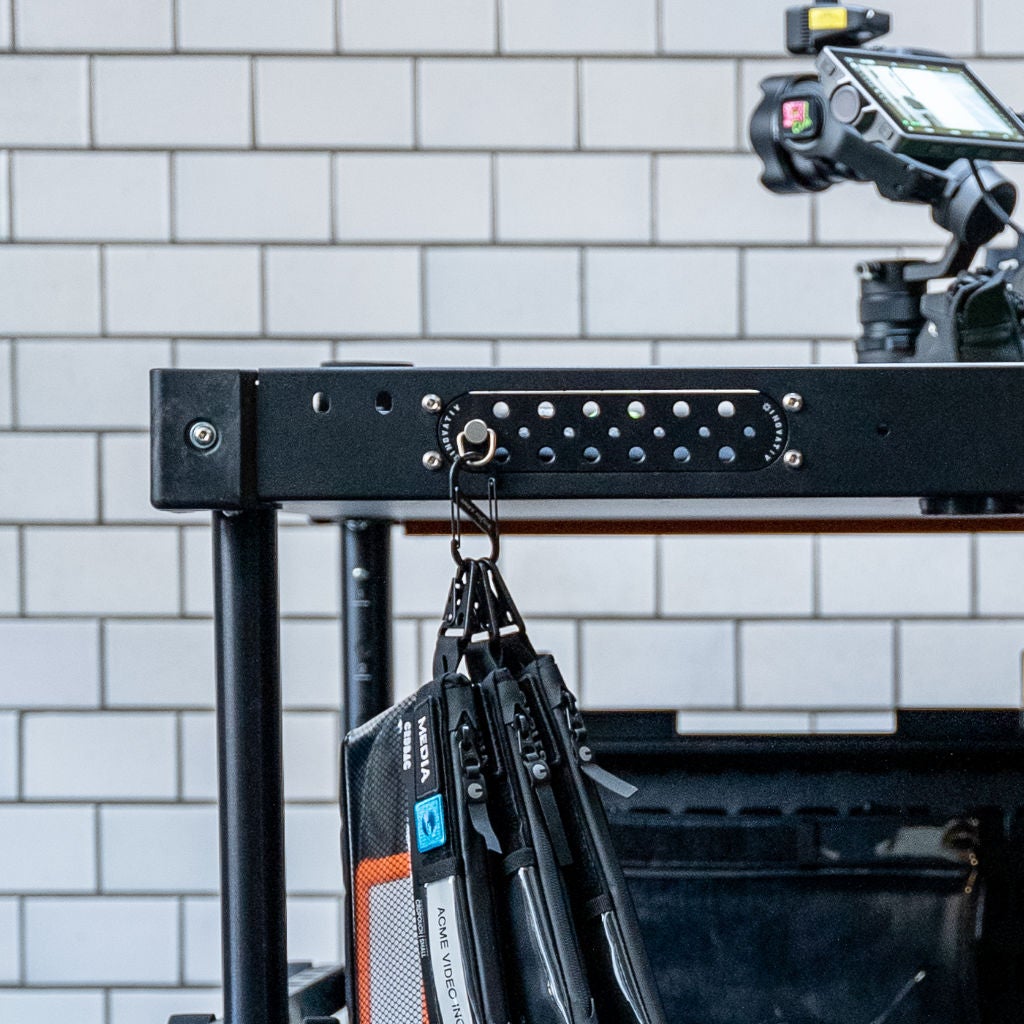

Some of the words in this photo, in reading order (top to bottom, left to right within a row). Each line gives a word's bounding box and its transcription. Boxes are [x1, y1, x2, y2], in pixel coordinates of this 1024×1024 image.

[441, 403, 460, 457] INOVATIV
[764, 409, 783, 461] INOVATIV
[417, 715, 431, 784] MEDIA
[437, 907, 449, 950] ACME
[442, 952, 458, 1000] VIDEO
